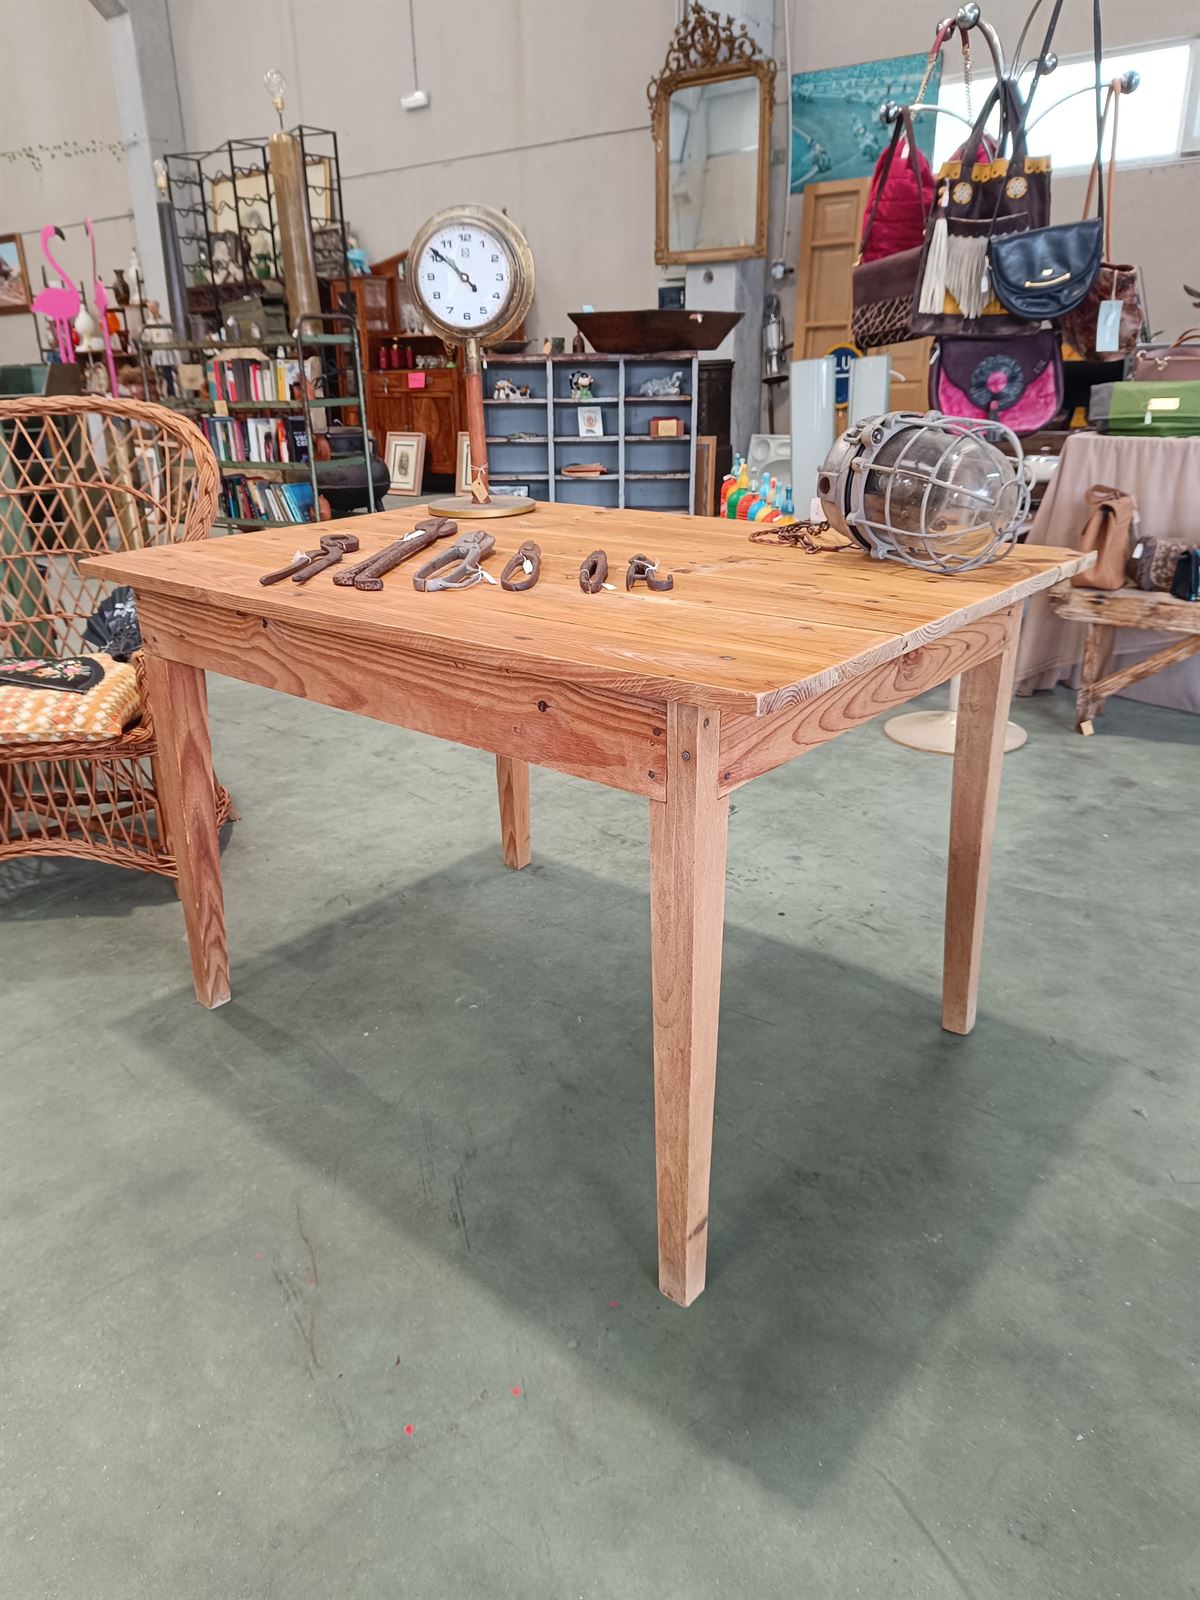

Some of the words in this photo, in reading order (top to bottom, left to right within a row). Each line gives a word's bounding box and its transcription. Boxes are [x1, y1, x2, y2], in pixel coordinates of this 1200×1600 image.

[458, 233, 471, 242] 12
[441, 240, 452, 248] 11
[480, 240, 484, 248] 1
